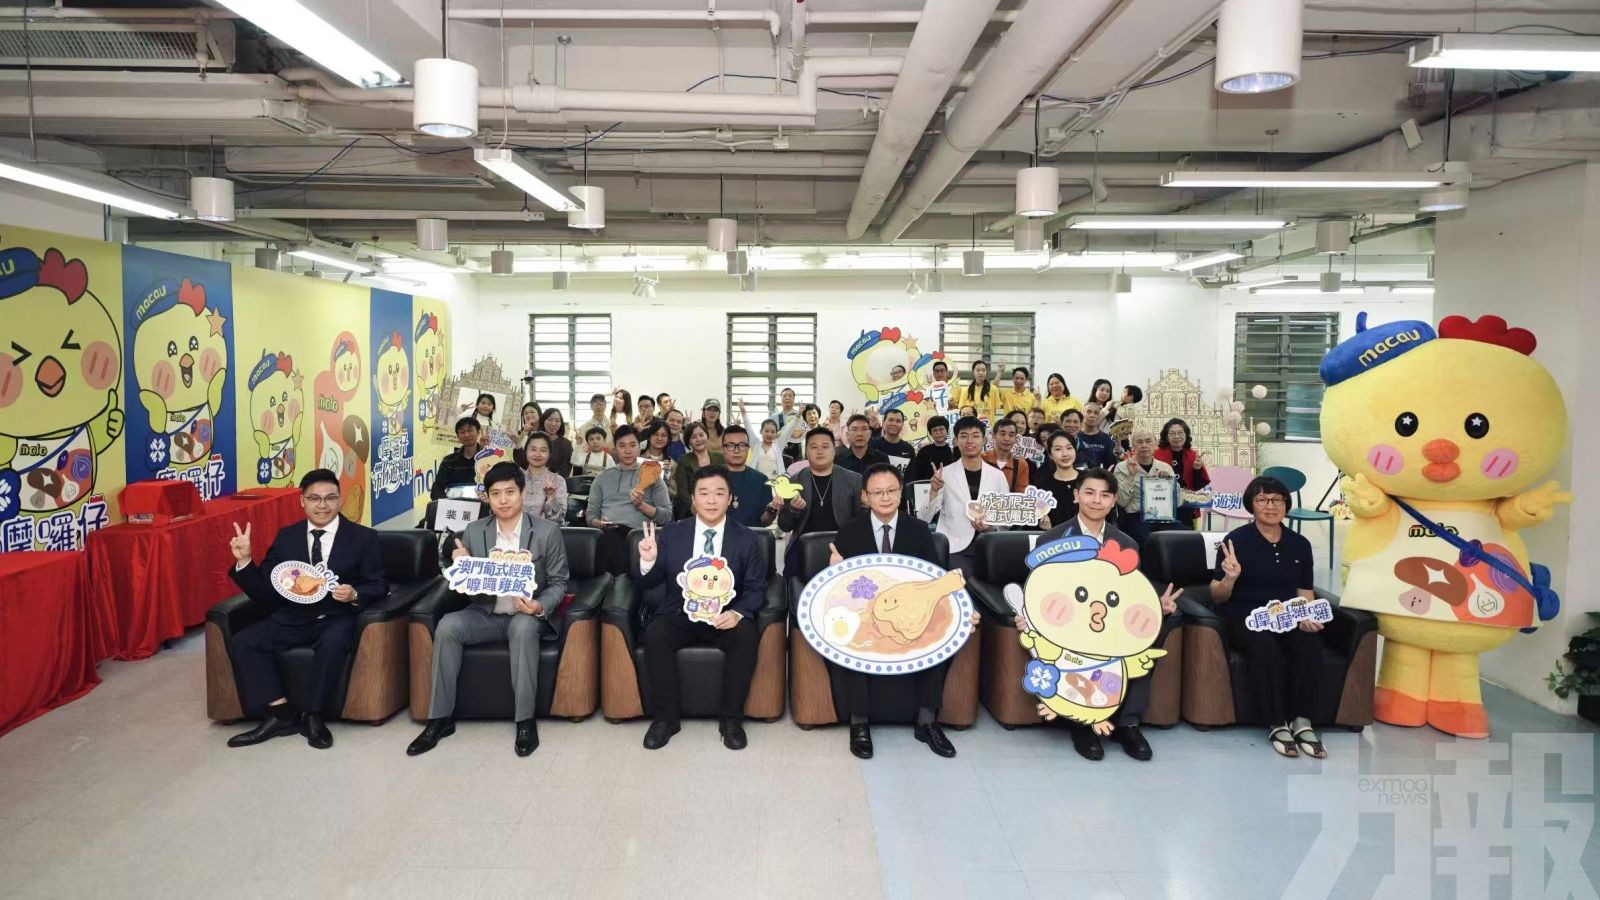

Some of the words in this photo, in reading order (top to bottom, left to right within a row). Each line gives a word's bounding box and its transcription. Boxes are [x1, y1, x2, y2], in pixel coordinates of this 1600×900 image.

[136, 285, 166, 320] macau
[852, 336, 871, 355] macau
[1358, 329, 1421, 367] macau
[252, 359, 270, 385] macau
[19, 443, 47, 456] molo
[980, 492, 1036, 511] 城市限定
[1027, 486, 1055, 508] molo
[1409, 523, 1459, 537] moo
[1036, 540, 1081, 562] macau
[458, 559, 533, 578] 澳門葡式經典
